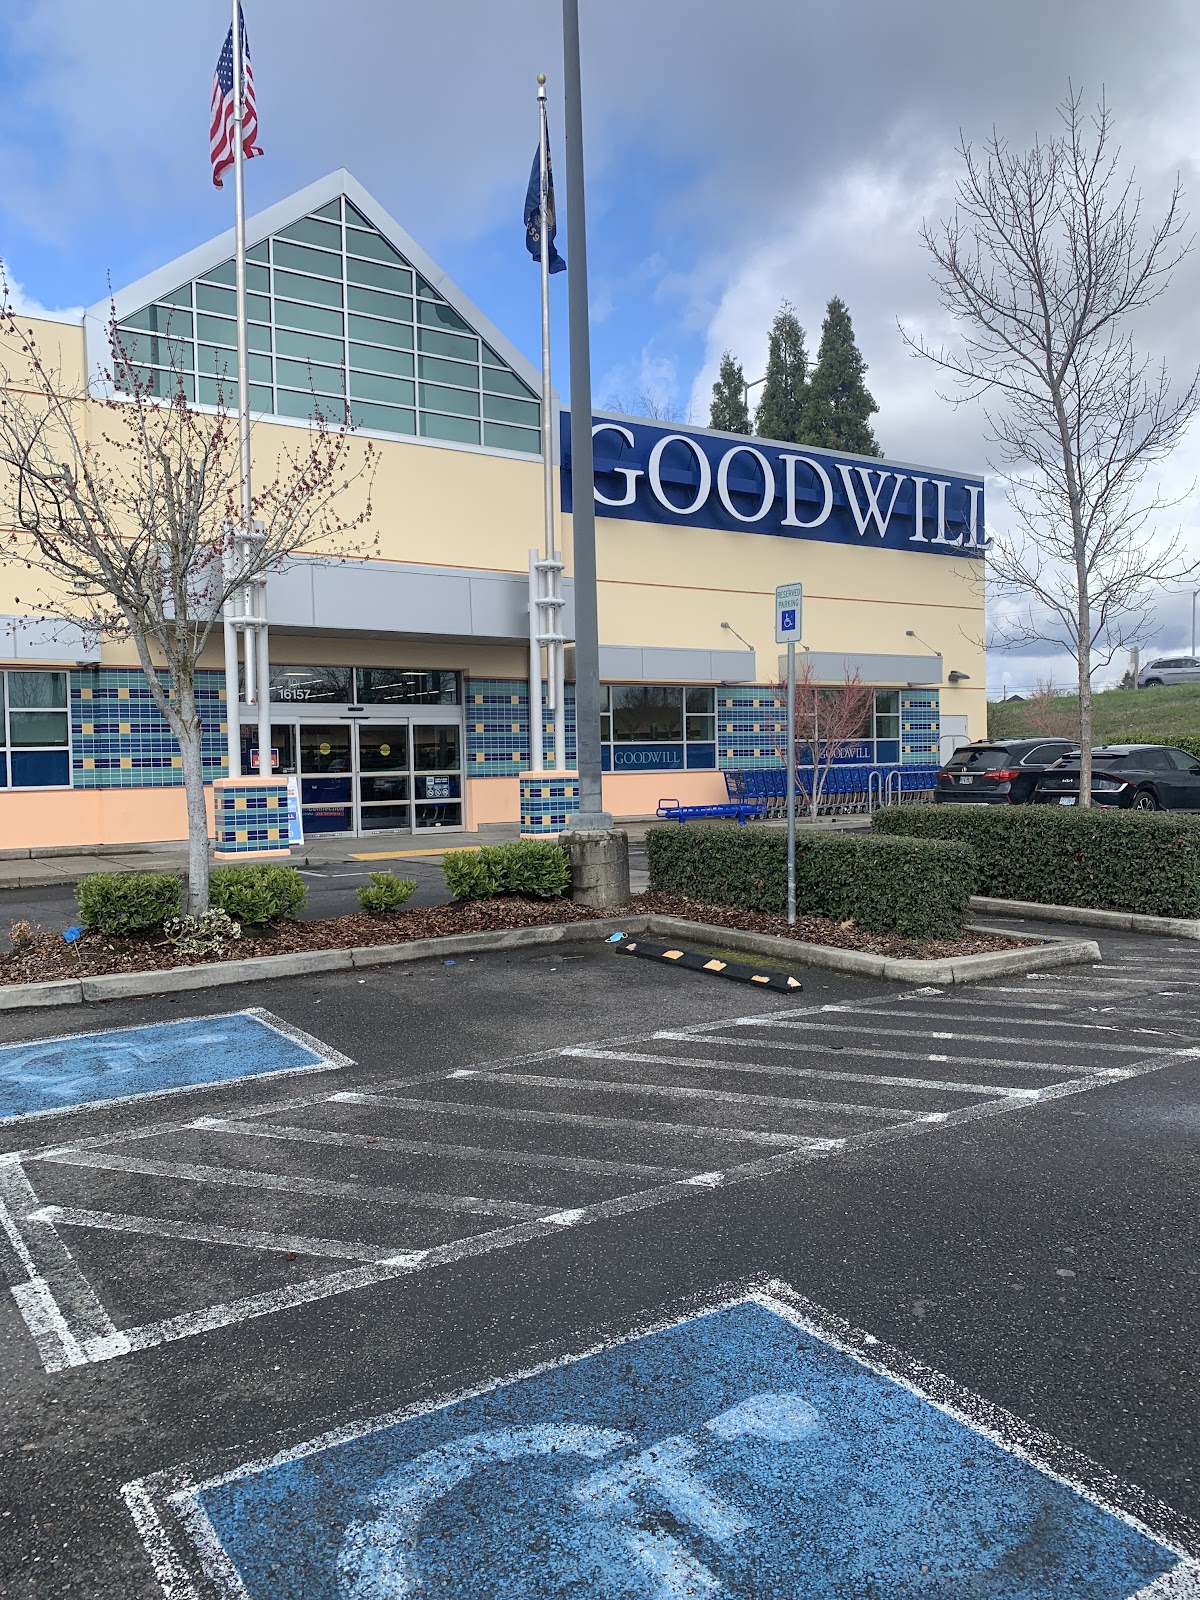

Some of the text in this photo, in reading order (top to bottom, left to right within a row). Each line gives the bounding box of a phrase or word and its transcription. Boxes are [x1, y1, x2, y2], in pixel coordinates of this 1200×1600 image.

[592, 422, 994, 551] GOODWILL
[777, 589, 801, 598] RESERVED
[778, 599, 799, 608] PARKING
[278, 688, 311, 700] 16157
[614, 751, 681, 764] GOODWILL
[819, 747, 871, 759] GOODWILL
